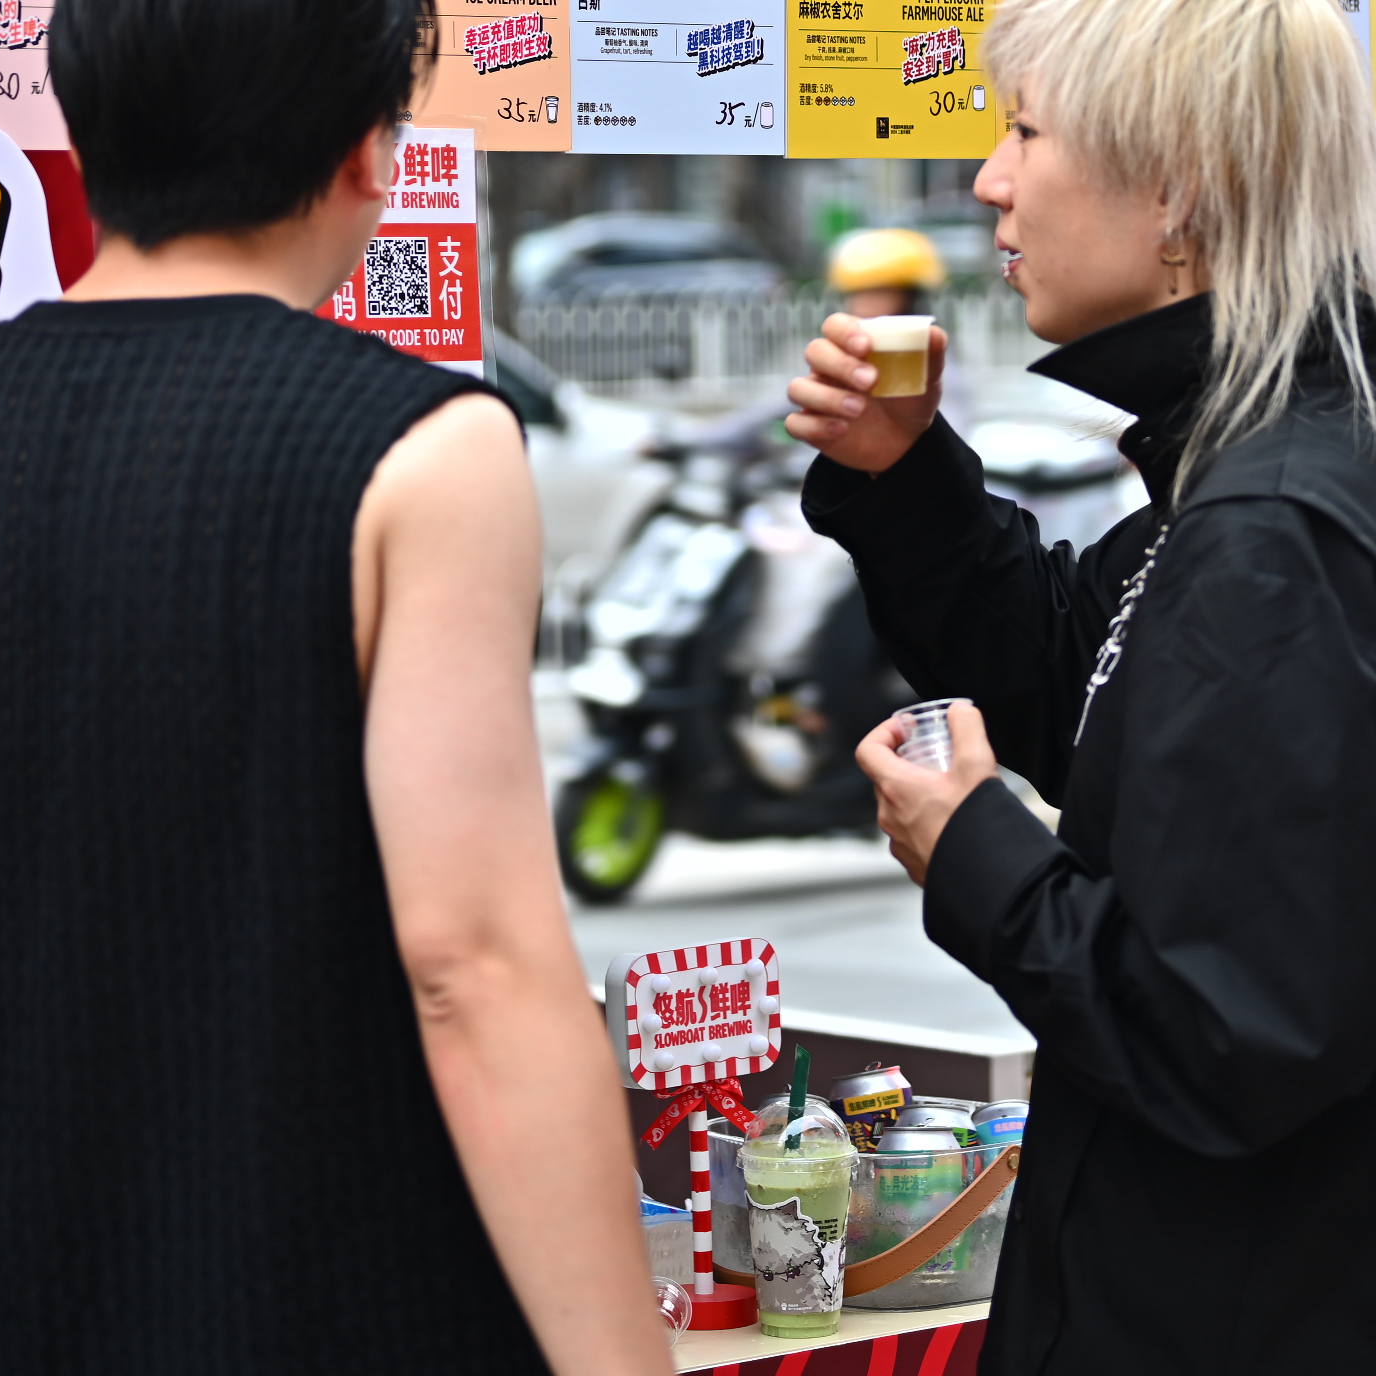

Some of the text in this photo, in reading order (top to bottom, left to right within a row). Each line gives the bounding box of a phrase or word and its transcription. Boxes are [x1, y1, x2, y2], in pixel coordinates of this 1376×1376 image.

[798, 0, 864, 21] 麻椒农舍艾尔
[902, 5, 984, 22] FARMHOUSE ALE
[465, 12, 540, 51] 幸运充值成功
[616, 27, 640, 37] TASTING
[641, 28, 658, 37] NOTES
[827, 35, 848, 44] TASTING
[849, 36, 866, 45] NOTES
[473, 33, 550, 70] 干杯即刻生效
[819, 84, 834, 93] 5.8%
[401, 191, 460, 209] BREWING
[437, 235, 463, 320] 支付
[389, 328, 464, 346] CODE TO PAY
[653, 1019, 753, 1050] SLOWBOAT BREWING
